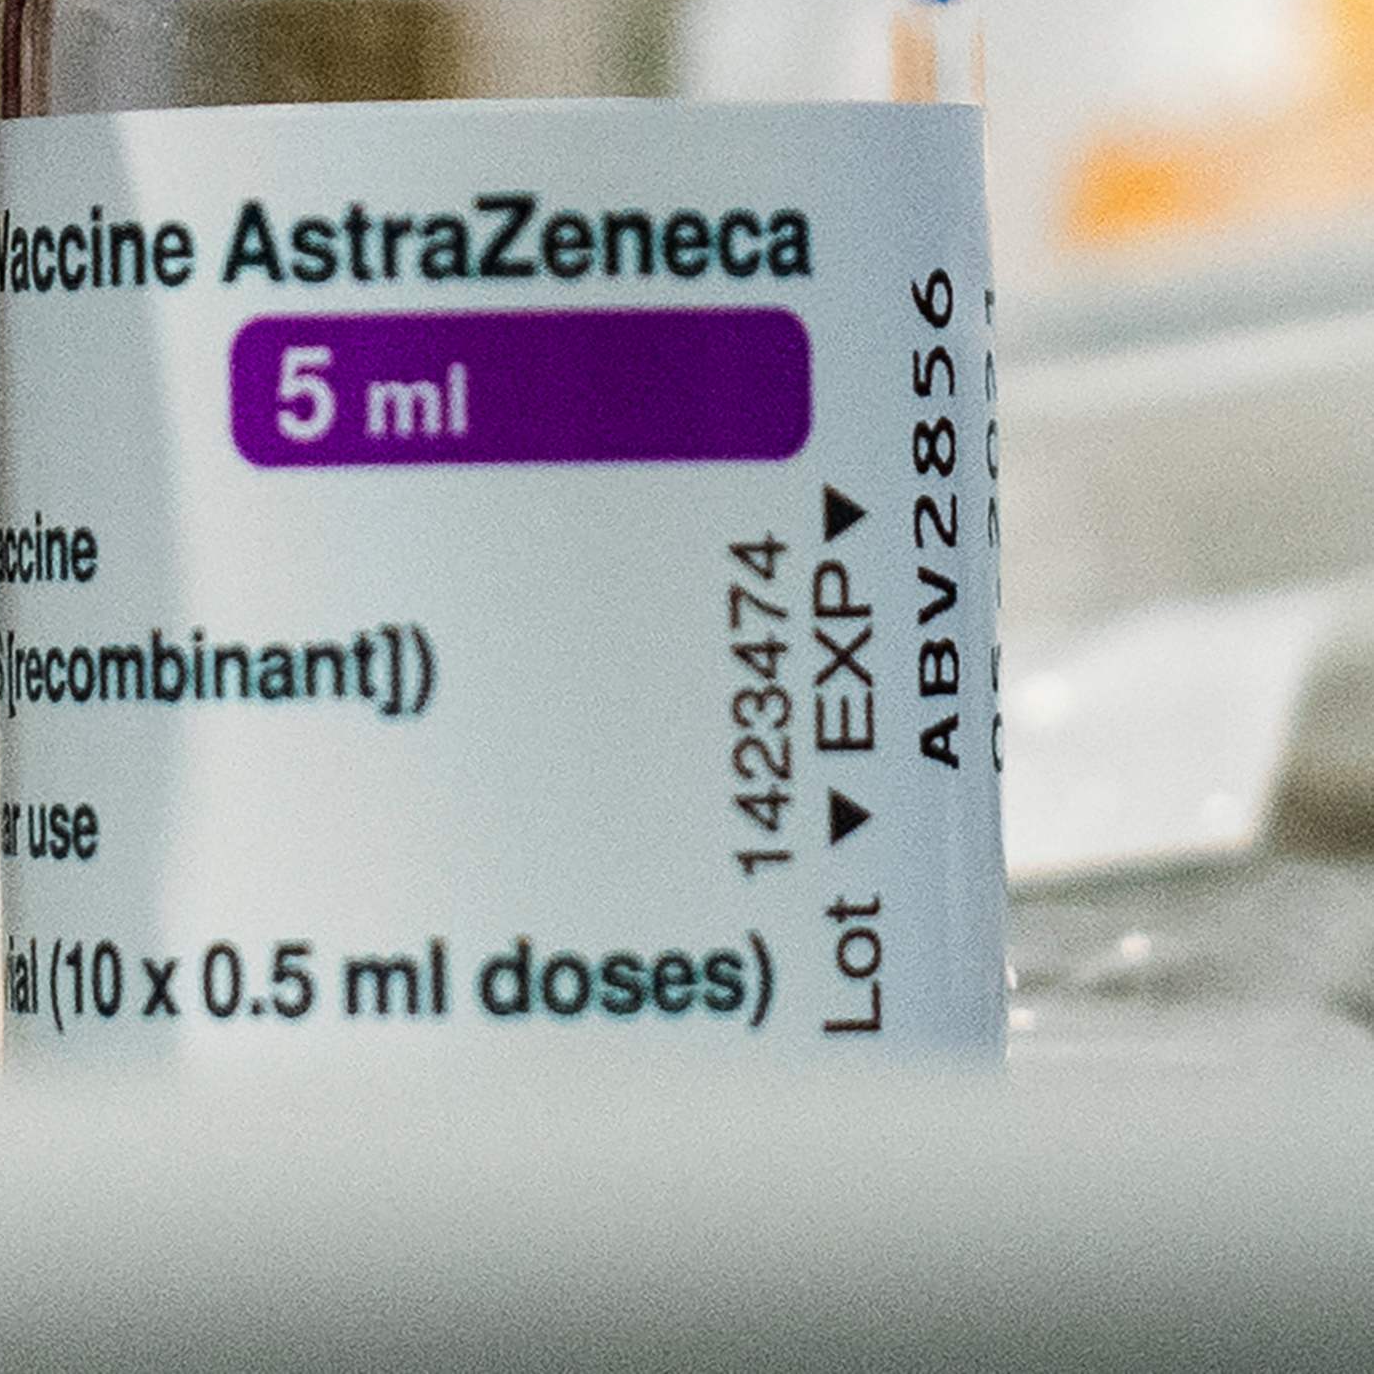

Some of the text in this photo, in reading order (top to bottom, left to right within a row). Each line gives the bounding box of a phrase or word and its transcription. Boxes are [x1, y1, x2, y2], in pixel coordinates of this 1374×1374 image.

[222, 191, 814, 285] AstraZeneca
[275, 343, 469, 443] 5 ml
[910, 267, 962, 771] ABV2856
[8, 628, 438, 718] [recombinant])
[726, 532, 795, 877] 1423474
[27, 802, 100, 862] use
[811, 558, 884, 1037] Lot EXP
[4, 931, 777, 1034] ial (10 x 0.5 ml doses)
